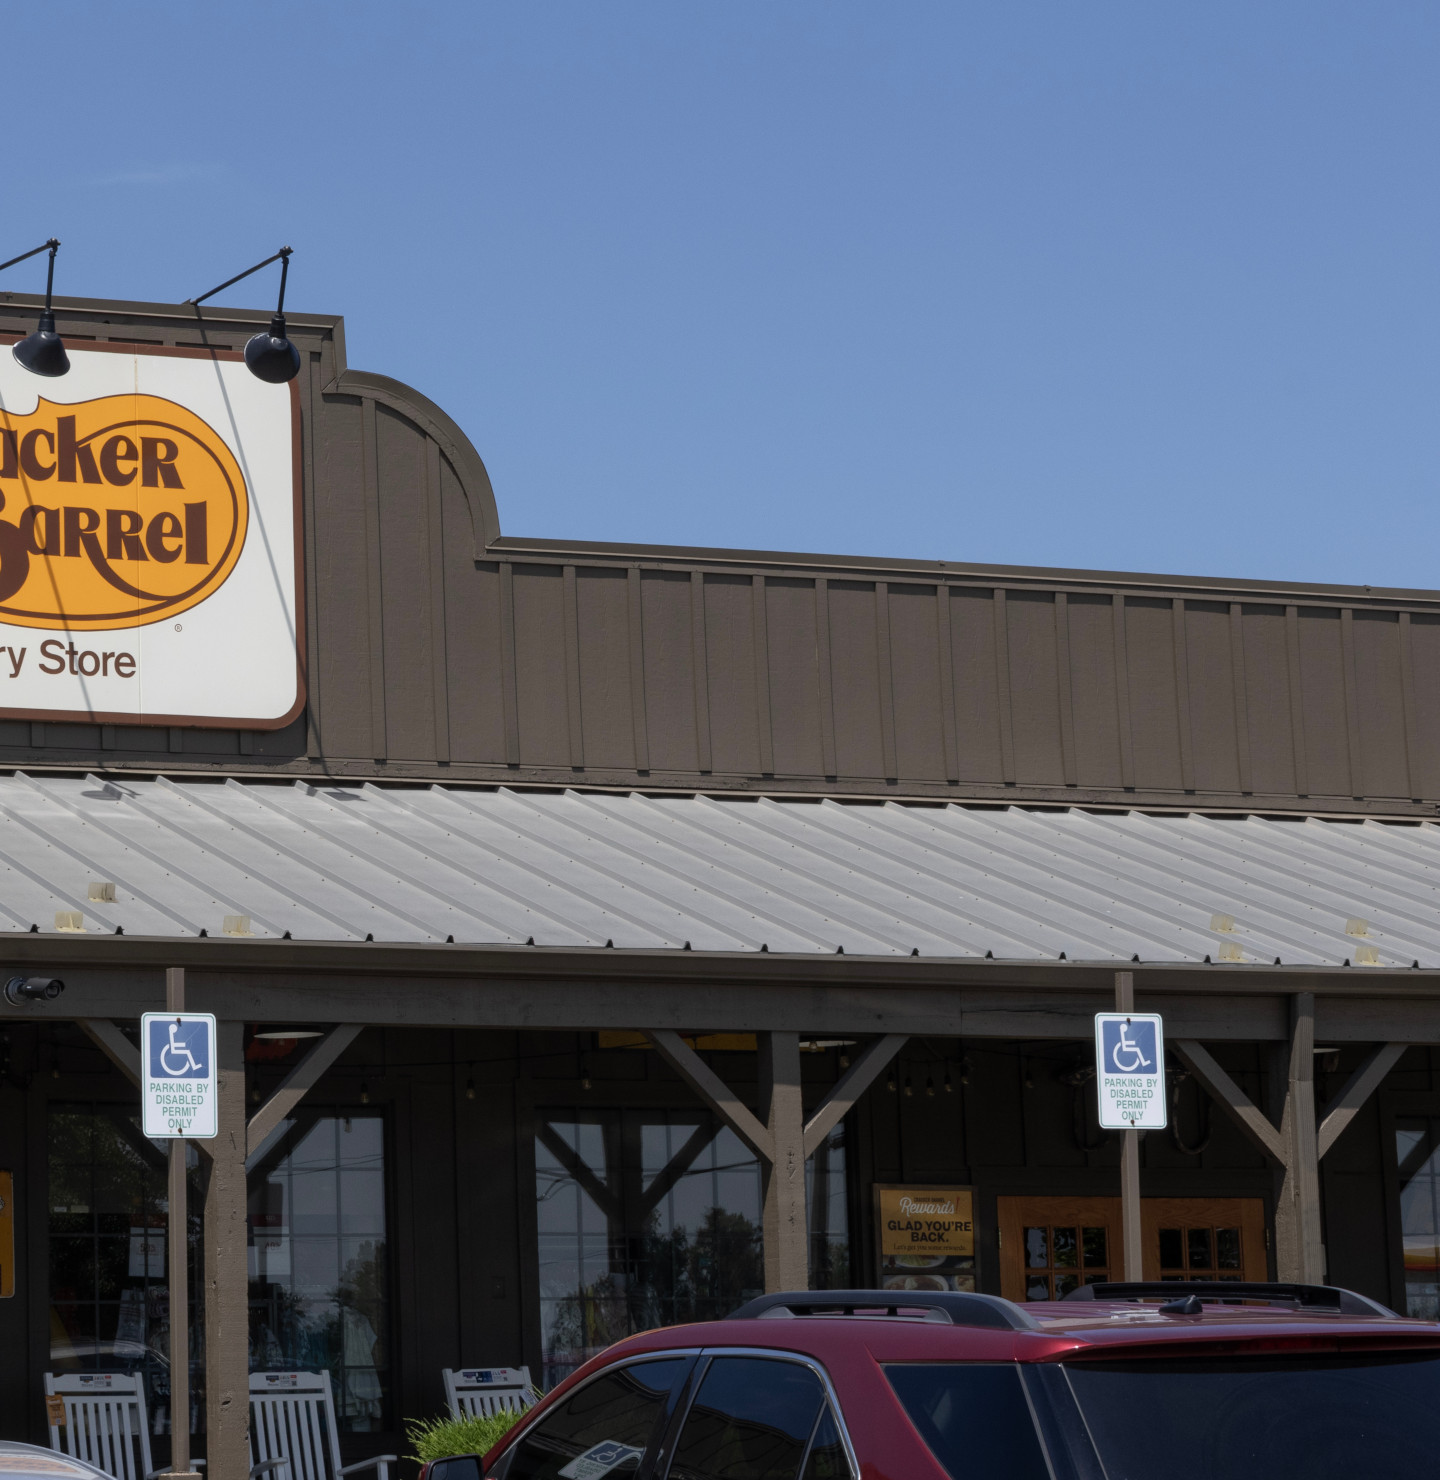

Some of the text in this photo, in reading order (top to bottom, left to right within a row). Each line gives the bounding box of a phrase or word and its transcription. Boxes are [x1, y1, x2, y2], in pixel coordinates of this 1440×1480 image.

[38, 639, 137, 678] Store
[150, 1083, 209, 1093] PARKING BY
[1104, 1078, 1158, 1087] PARKING BY
[155, 1094, 204, 1105] DISABLED
[1110, 1089, 1154, 1099] DISABLED
[1116, 1100, 1148, 1109] PERMIT
[162, 1106, 198, 1117] PERMIT
[1121, 1110, 1144, 1120] ONLY
[167, 1118, 192, 1129] ONLY
[899, 1196, 955, 1218] Rewards
[887, 1220, 972, 1232] GLAD YOU'RE
[911, 1232, 949, 1243] BACK.
